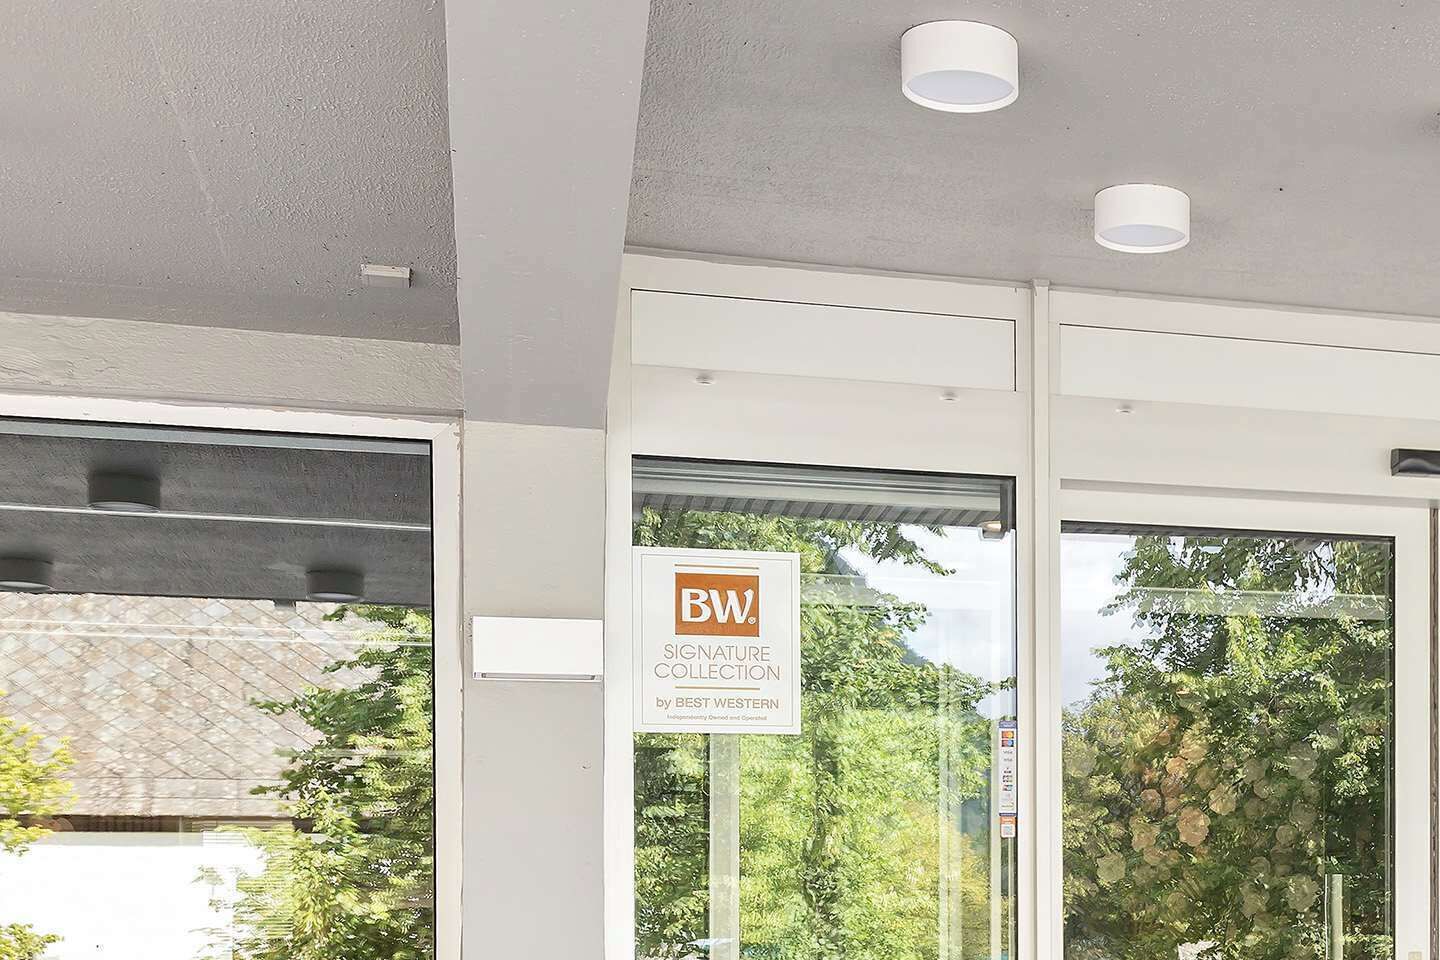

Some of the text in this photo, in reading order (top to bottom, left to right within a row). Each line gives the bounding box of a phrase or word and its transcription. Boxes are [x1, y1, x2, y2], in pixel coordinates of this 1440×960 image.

[664, 644, 771, 662] SIGNATURE
[654, 663, 780, 681] COLLECTION
[656, 697, 779, 710] by BEST WESTERN
